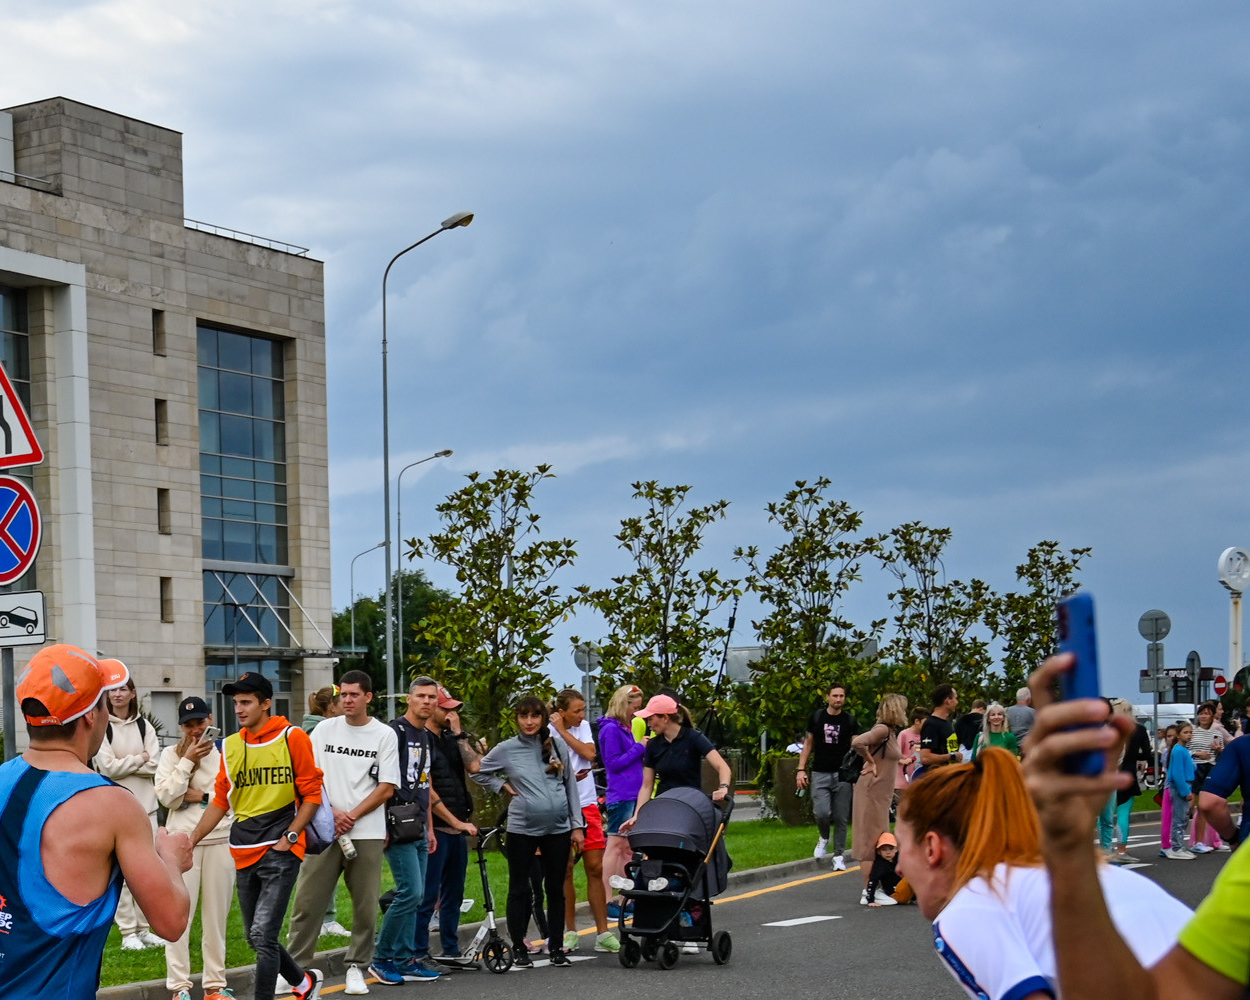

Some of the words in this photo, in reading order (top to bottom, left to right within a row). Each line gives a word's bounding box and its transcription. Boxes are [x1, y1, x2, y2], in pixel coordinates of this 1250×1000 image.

[1169, 670, 1188, 678] ПРОДА
[336, 746, 378, 759] SANDER
[234, 766, 293, 789] VOLUNTEER
